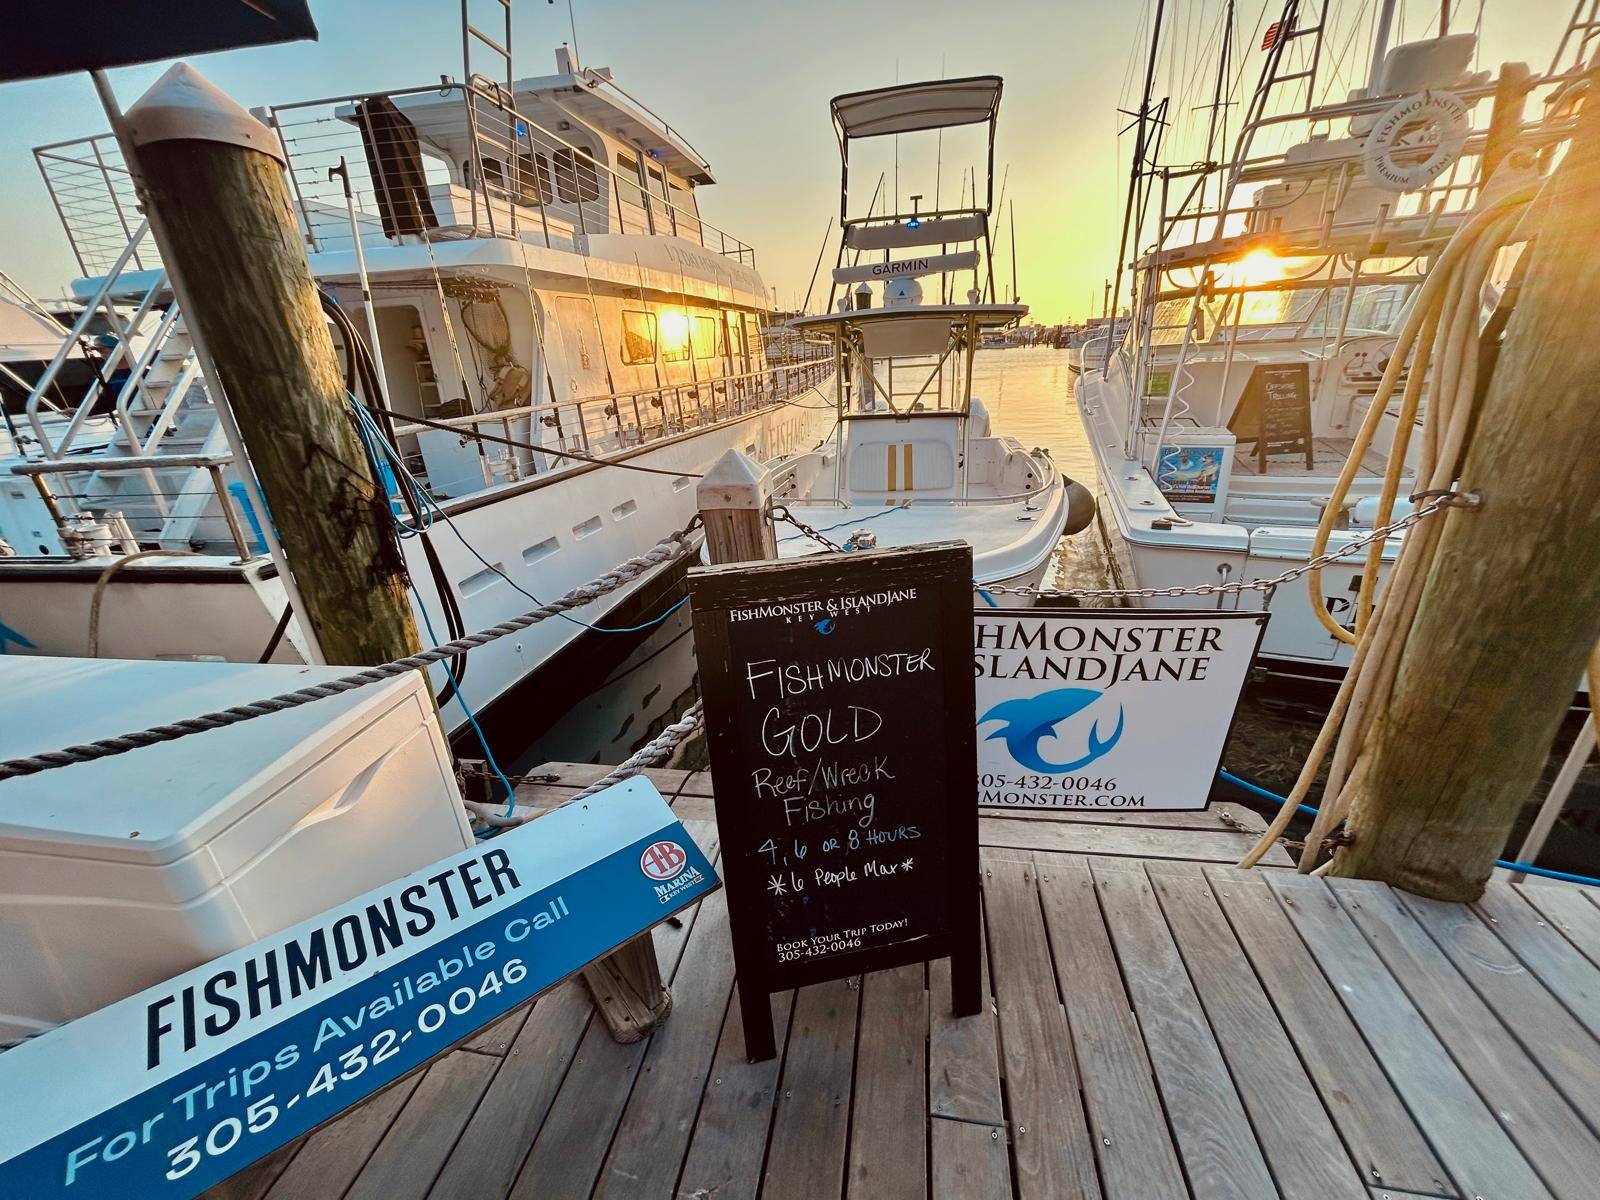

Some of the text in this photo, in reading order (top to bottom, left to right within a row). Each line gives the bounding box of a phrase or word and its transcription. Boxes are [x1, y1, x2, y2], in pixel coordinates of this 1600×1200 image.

[872, 259, 929, 275] GARMIN
[730, 588, 917, 622] FISHMONSTER & ISLANDJANE
[785, 605, 871, 624] KEY WEST
[747, 647, 935, 700] FISHMONSTER
[762, 705, 882, 757] GOLD
[977, 774, 1117, 791] 05-432-0046
[978, 790, 1146, 807] MONSTER.COM
[784, 793, 876, 827] Fishing
[848, 829, 860, 850] 8
[653, 866, 701, 897] MARINA
[814, 866, 858, 887] People
[776, 918, 908, 953] BOOK YOUR TRIP TODAY!
[778, 937, 862, 963] 305-432-0046
[146, 848, 522, 1071] FISHMONSTER
[65, 895, 570, 1186] For Trips Available Call
[165, 958, 528, 1182] 305-432-0046
